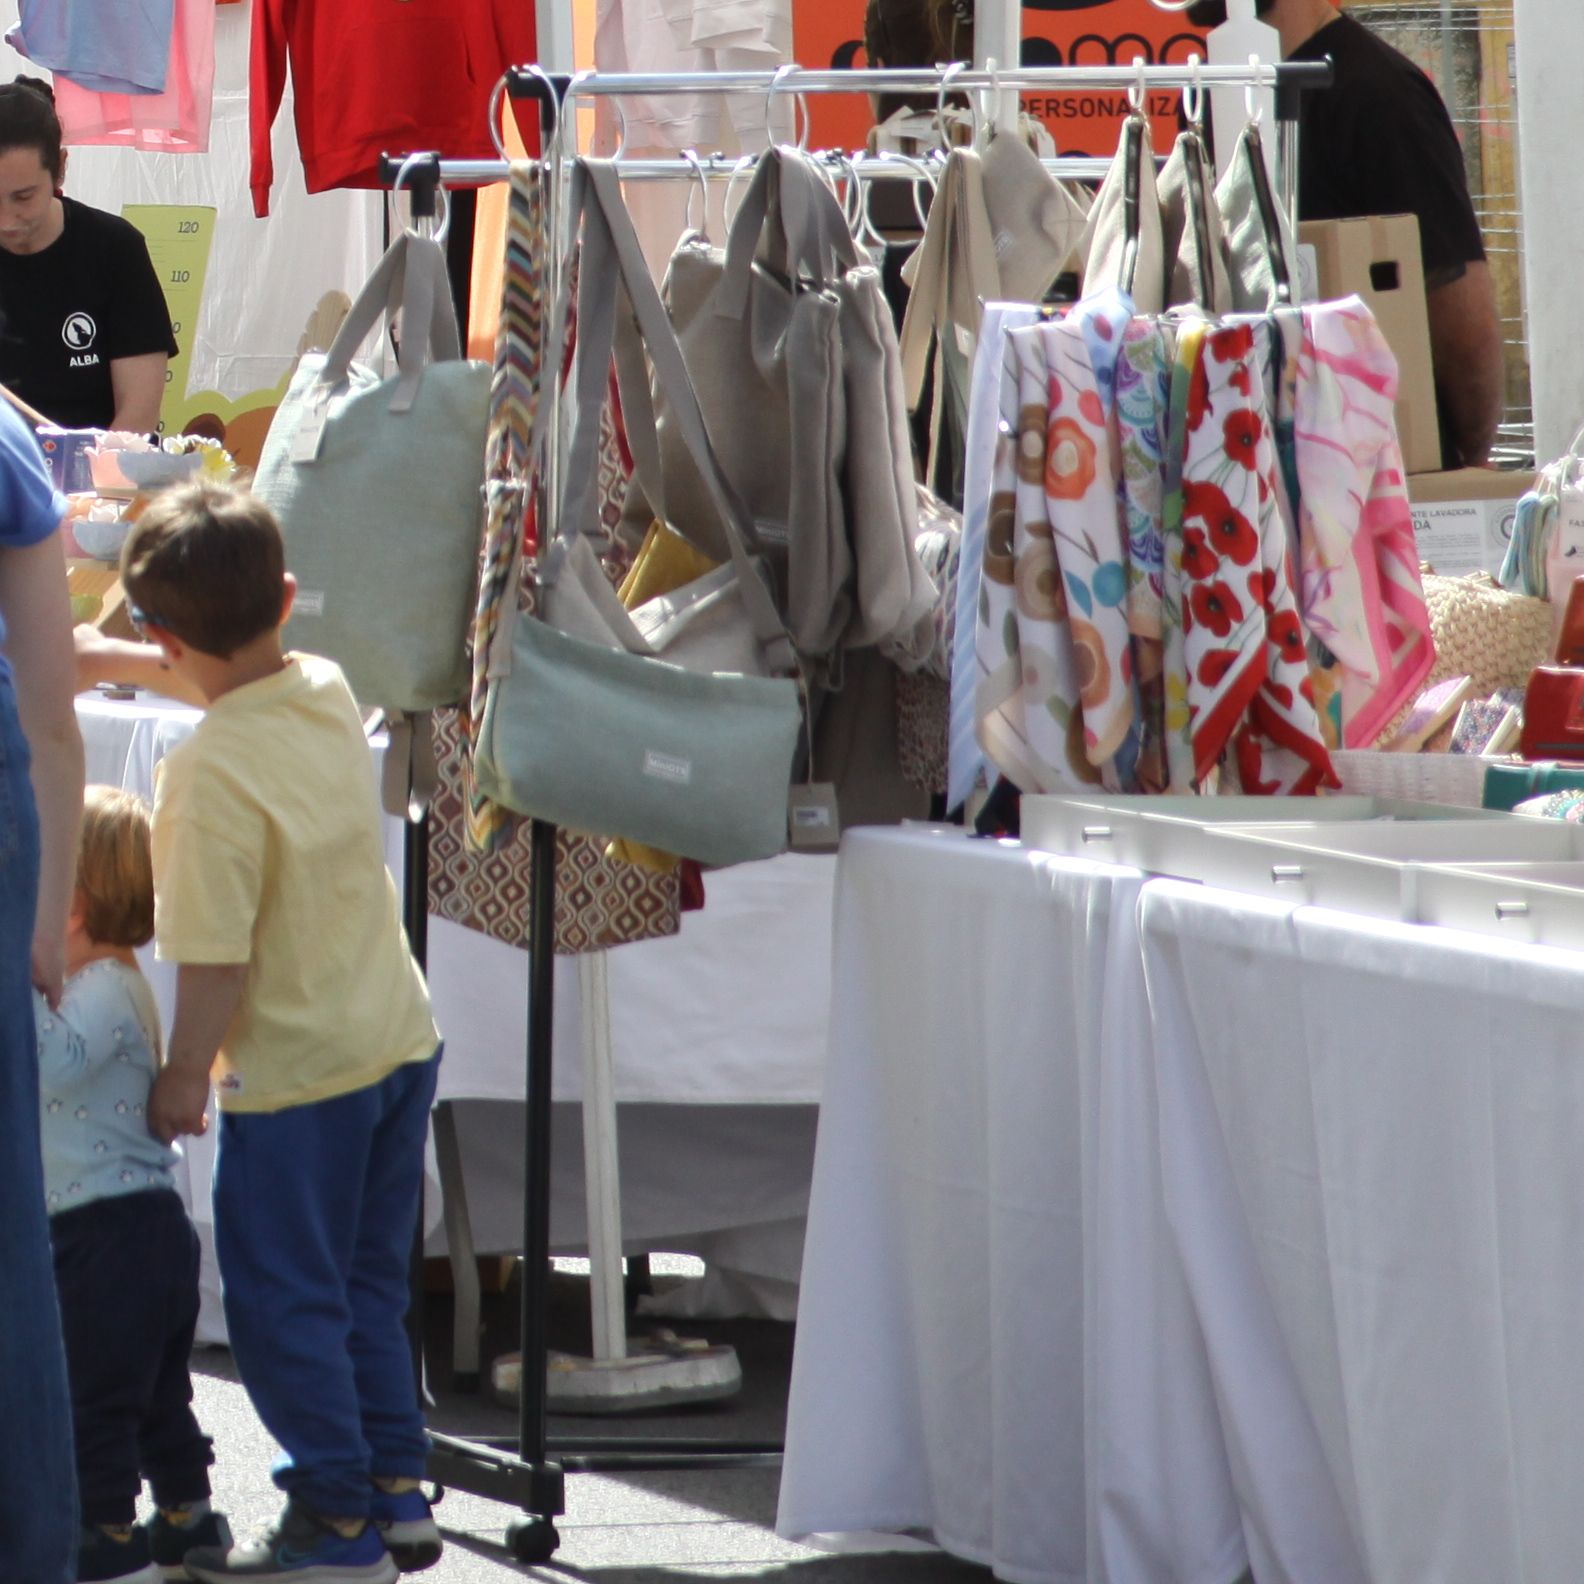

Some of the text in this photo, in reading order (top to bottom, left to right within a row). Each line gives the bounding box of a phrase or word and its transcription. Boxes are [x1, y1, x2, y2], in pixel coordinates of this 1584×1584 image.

[178, 221, 199, 234] 120
[171, 270, 190, 283] 110
[69, 353, 100, 368] ALBA
